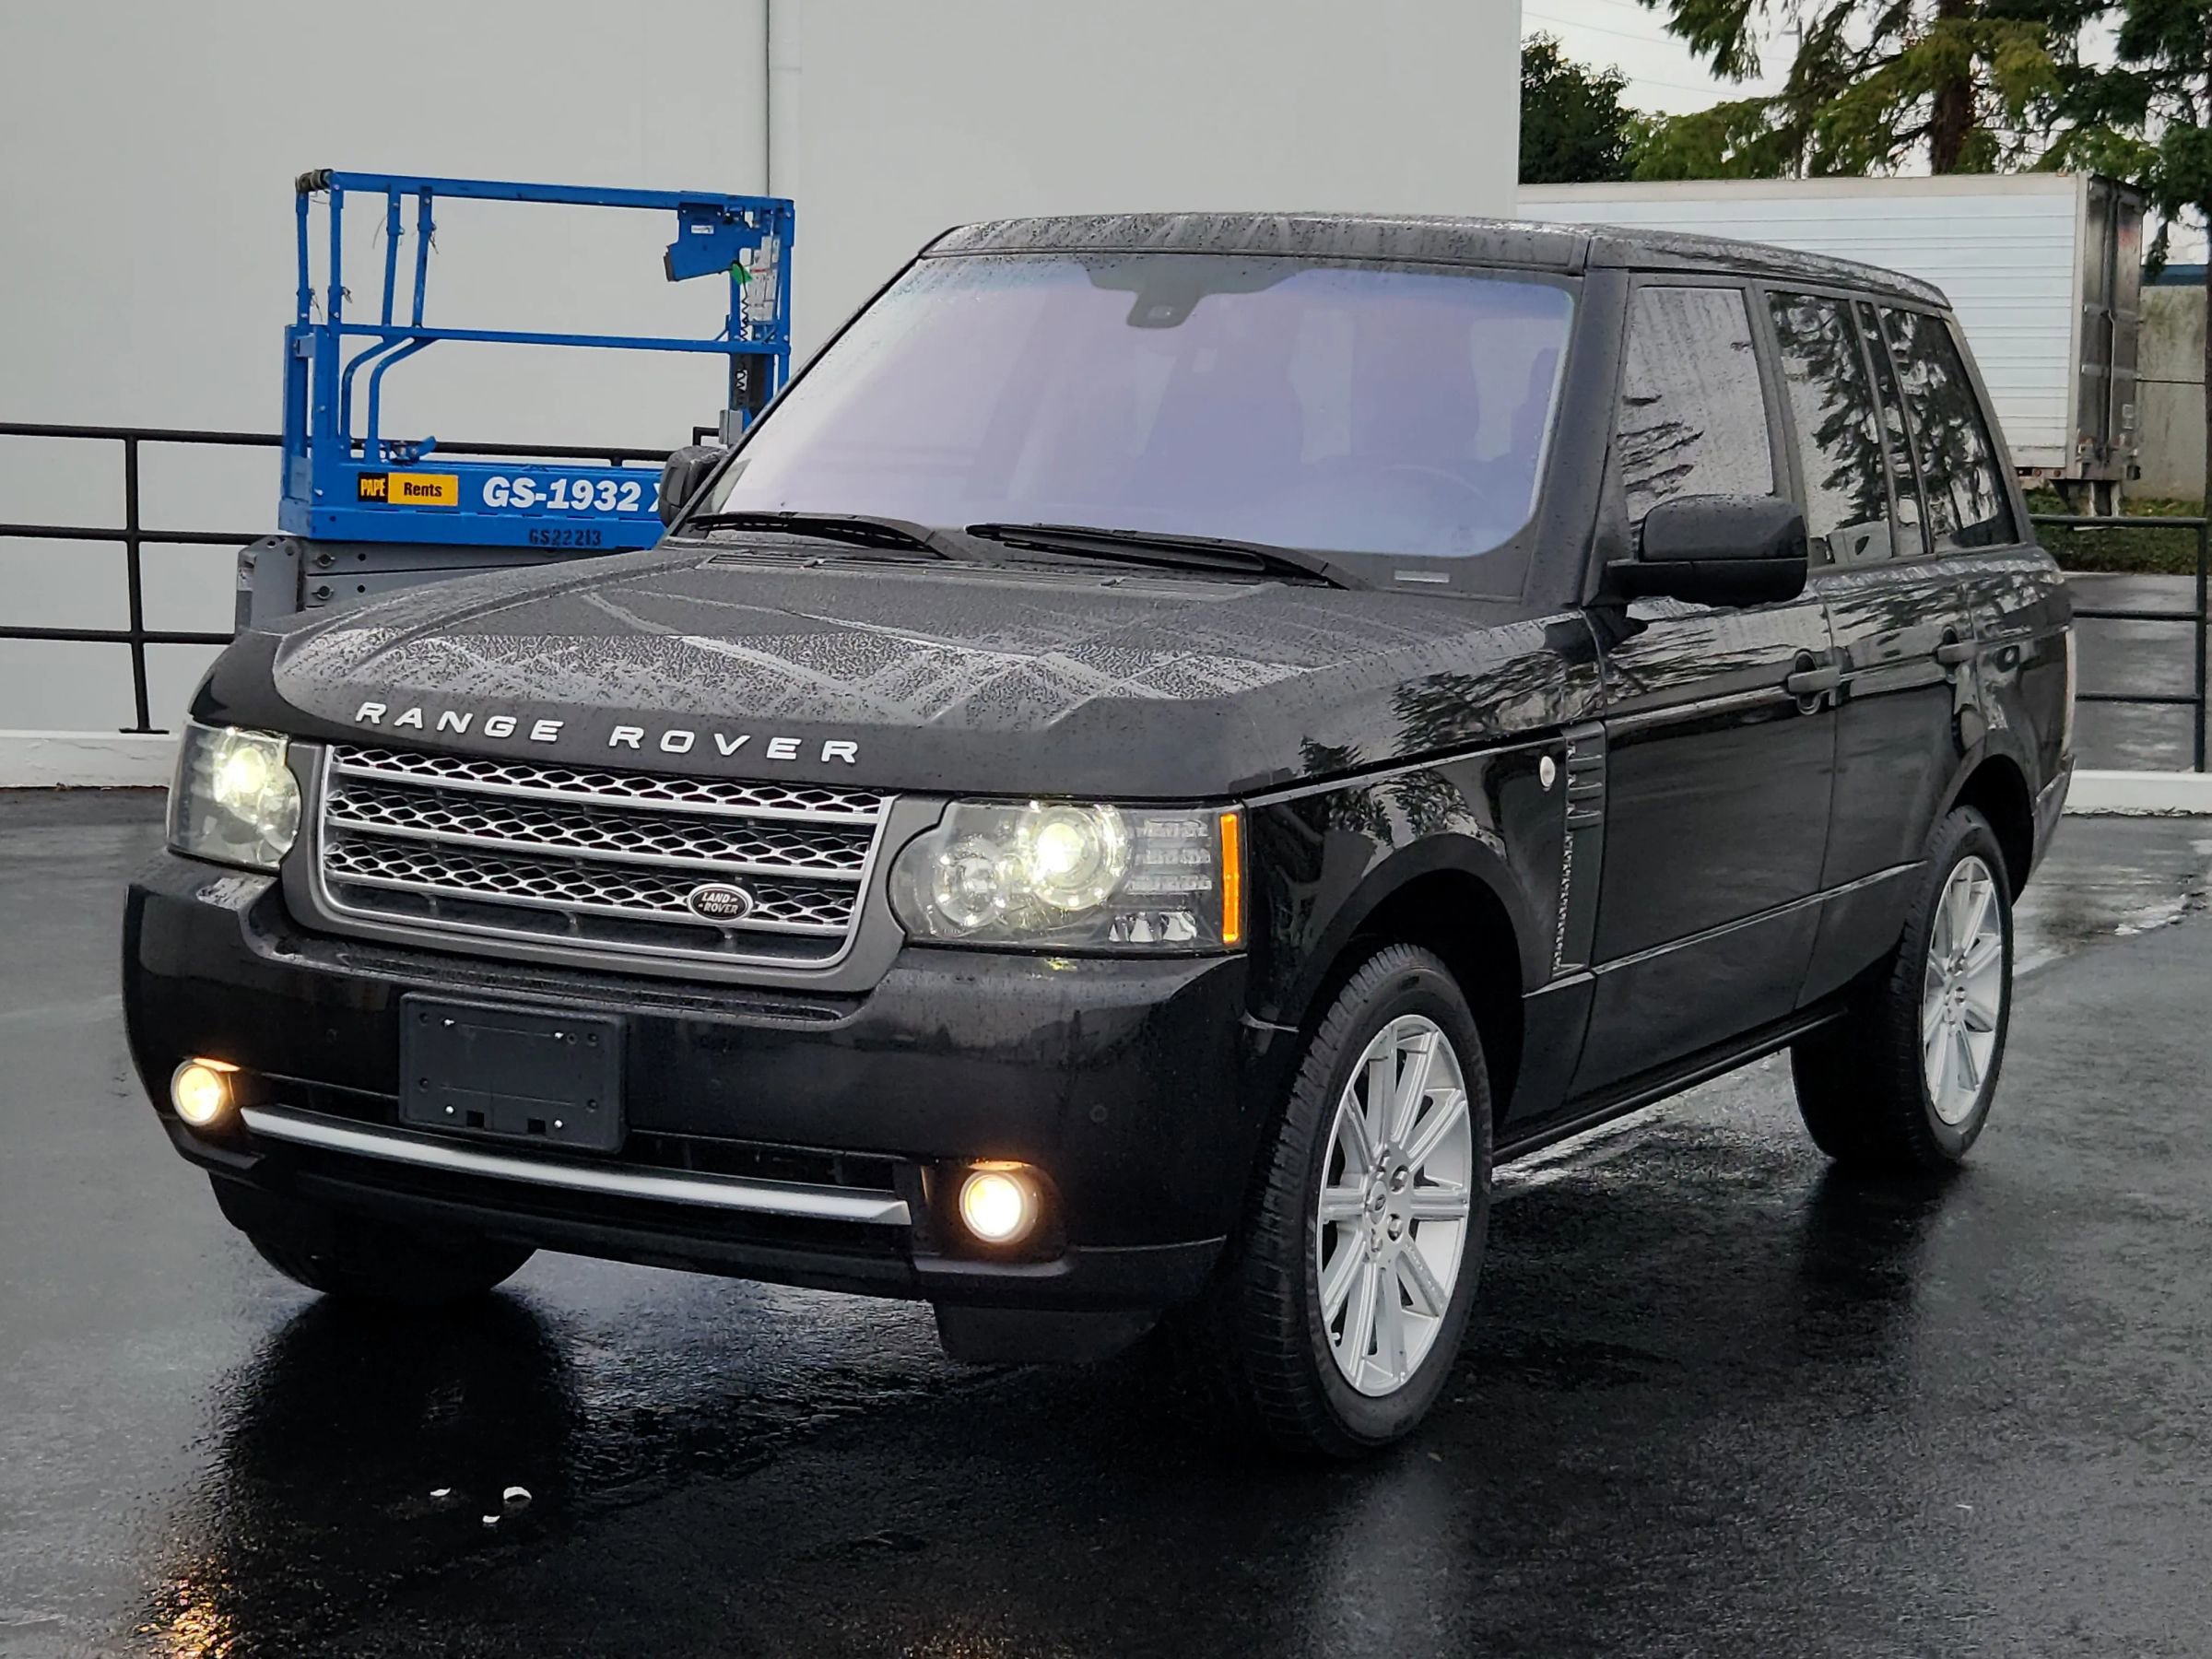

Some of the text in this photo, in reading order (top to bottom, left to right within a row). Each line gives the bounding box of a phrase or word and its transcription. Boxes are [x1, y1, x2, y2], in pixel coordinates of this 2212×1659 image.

[404, 482, 442, 498] Rents
[482, 477, 641, 512] GS-1932
[529, 529, 602, 547] GS22213
[355, 701, 859, 764] RANGE ROVER
[701, 892, 731, 903] LAND
[703, 902, 738, 914] ROVER
